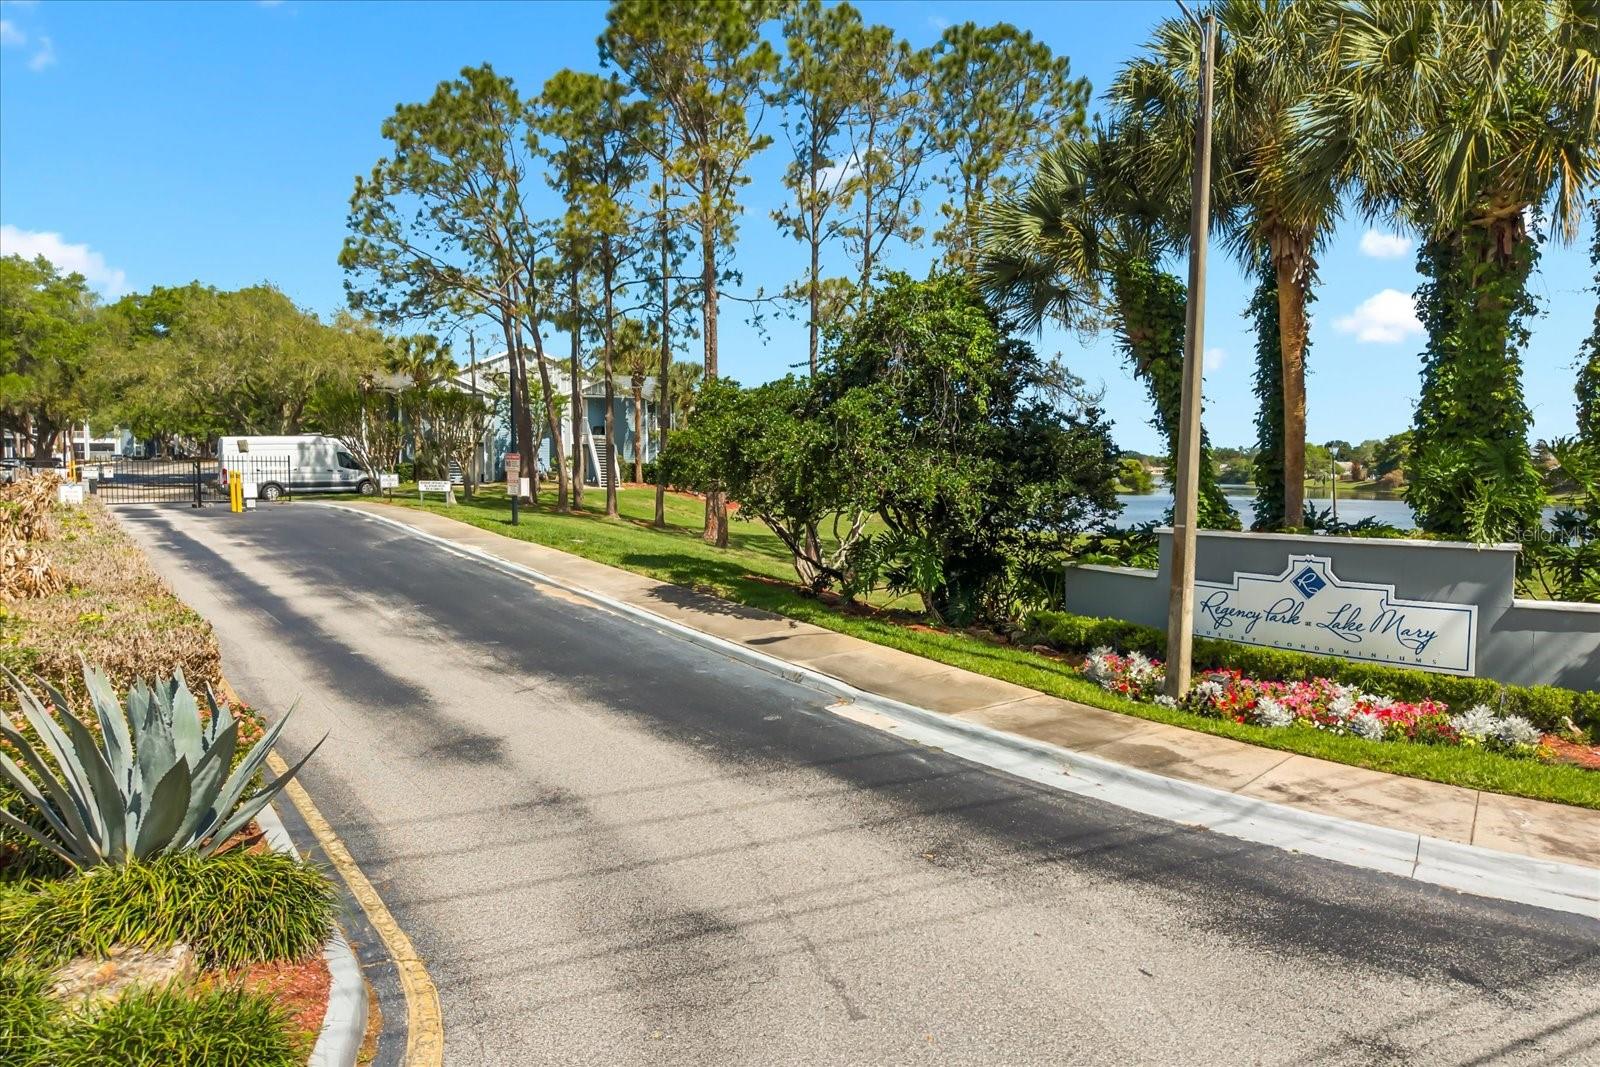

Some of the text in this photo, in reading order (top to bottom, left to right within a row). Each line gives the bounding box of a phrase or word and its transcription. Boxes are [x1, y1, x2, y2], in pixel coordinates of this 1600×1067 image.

[1196, 629, 1437, 665] LUXURY CONDOMINIUMS
[1200, 591, 1262, 634] Regency
[1263, 598, 1305, 625] Park
[1316, 603, 1366, 643] Lake
[1369, 598, 1438, 655] Mary
